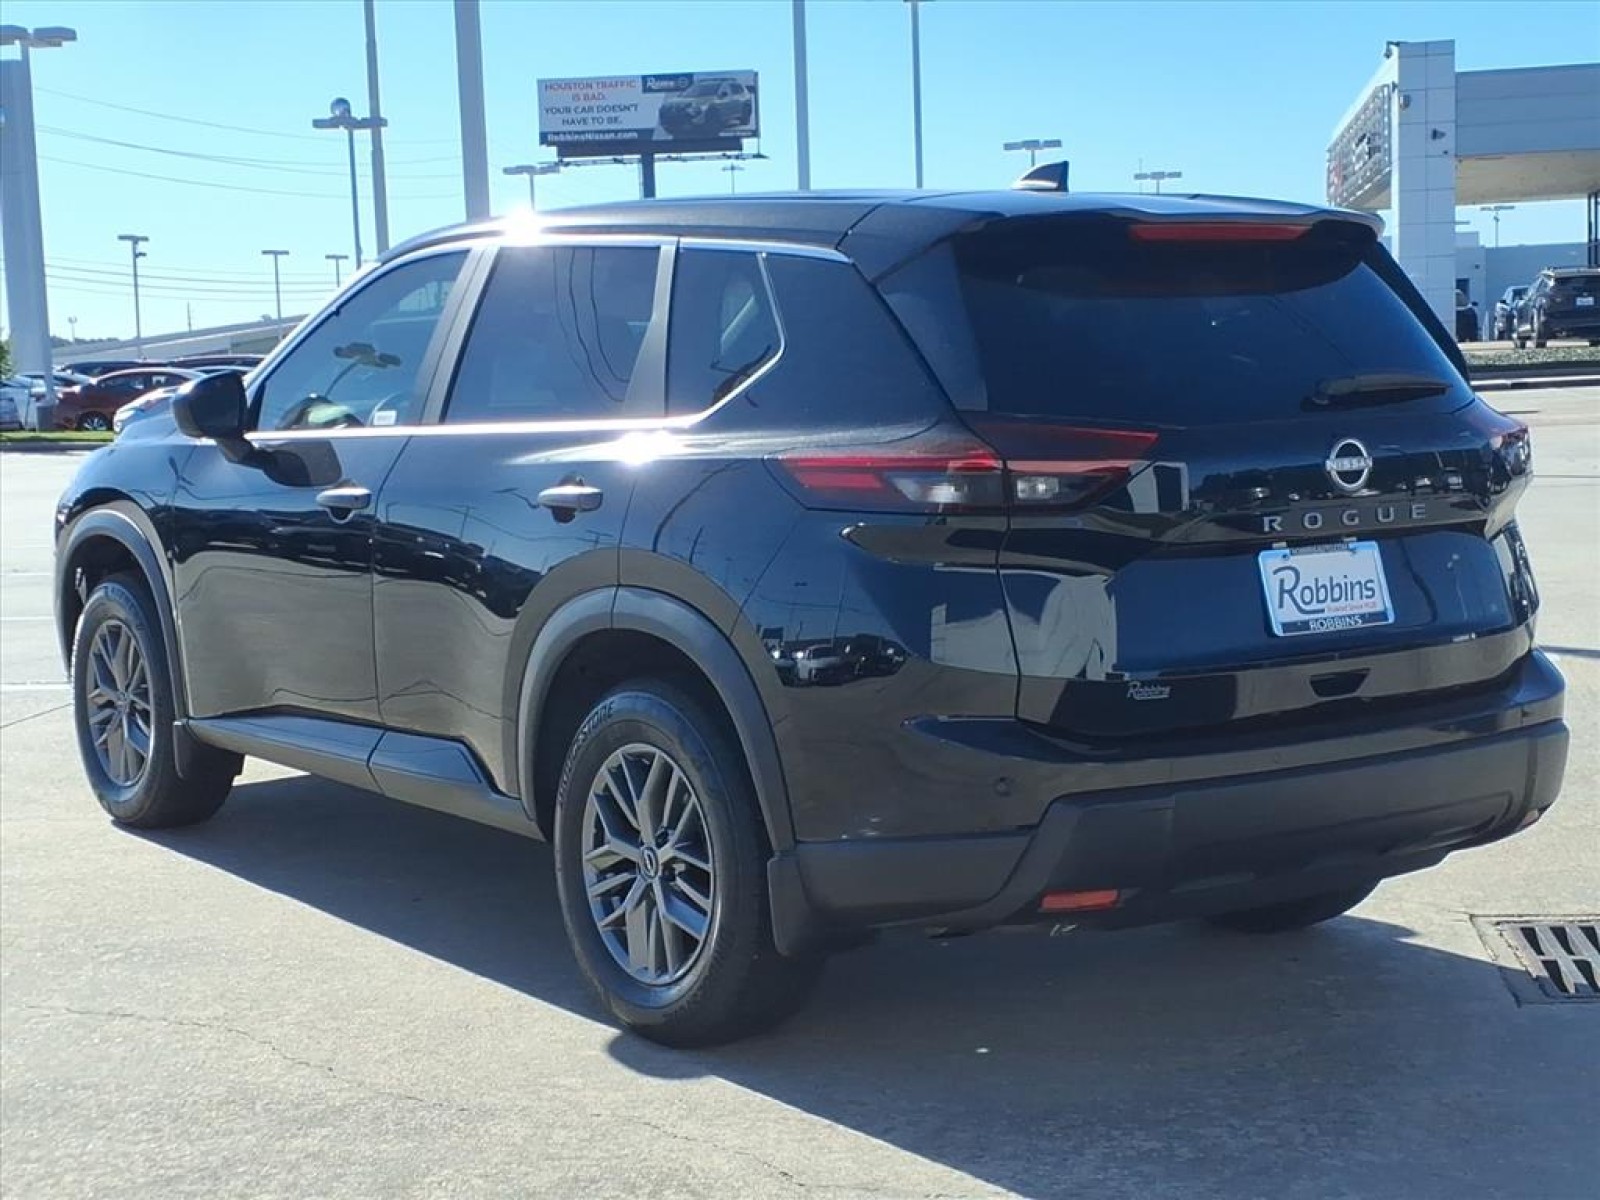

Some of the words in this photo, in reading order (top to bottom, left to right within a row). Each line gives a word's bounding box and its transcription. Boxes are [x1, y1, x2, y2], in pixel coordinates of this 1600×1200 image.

[545, 106, 571, 114] YOUR
[573, 105, 595, 114] CAR
[562, 117, 588, 125] HAVE
[591, 117, 604, 125] TO
[1263, 503, 1426, 532] ROGUE
[1273, 565, 1376, 614] Robbins
[1309, 615, 1362, 631] ROBBINS
